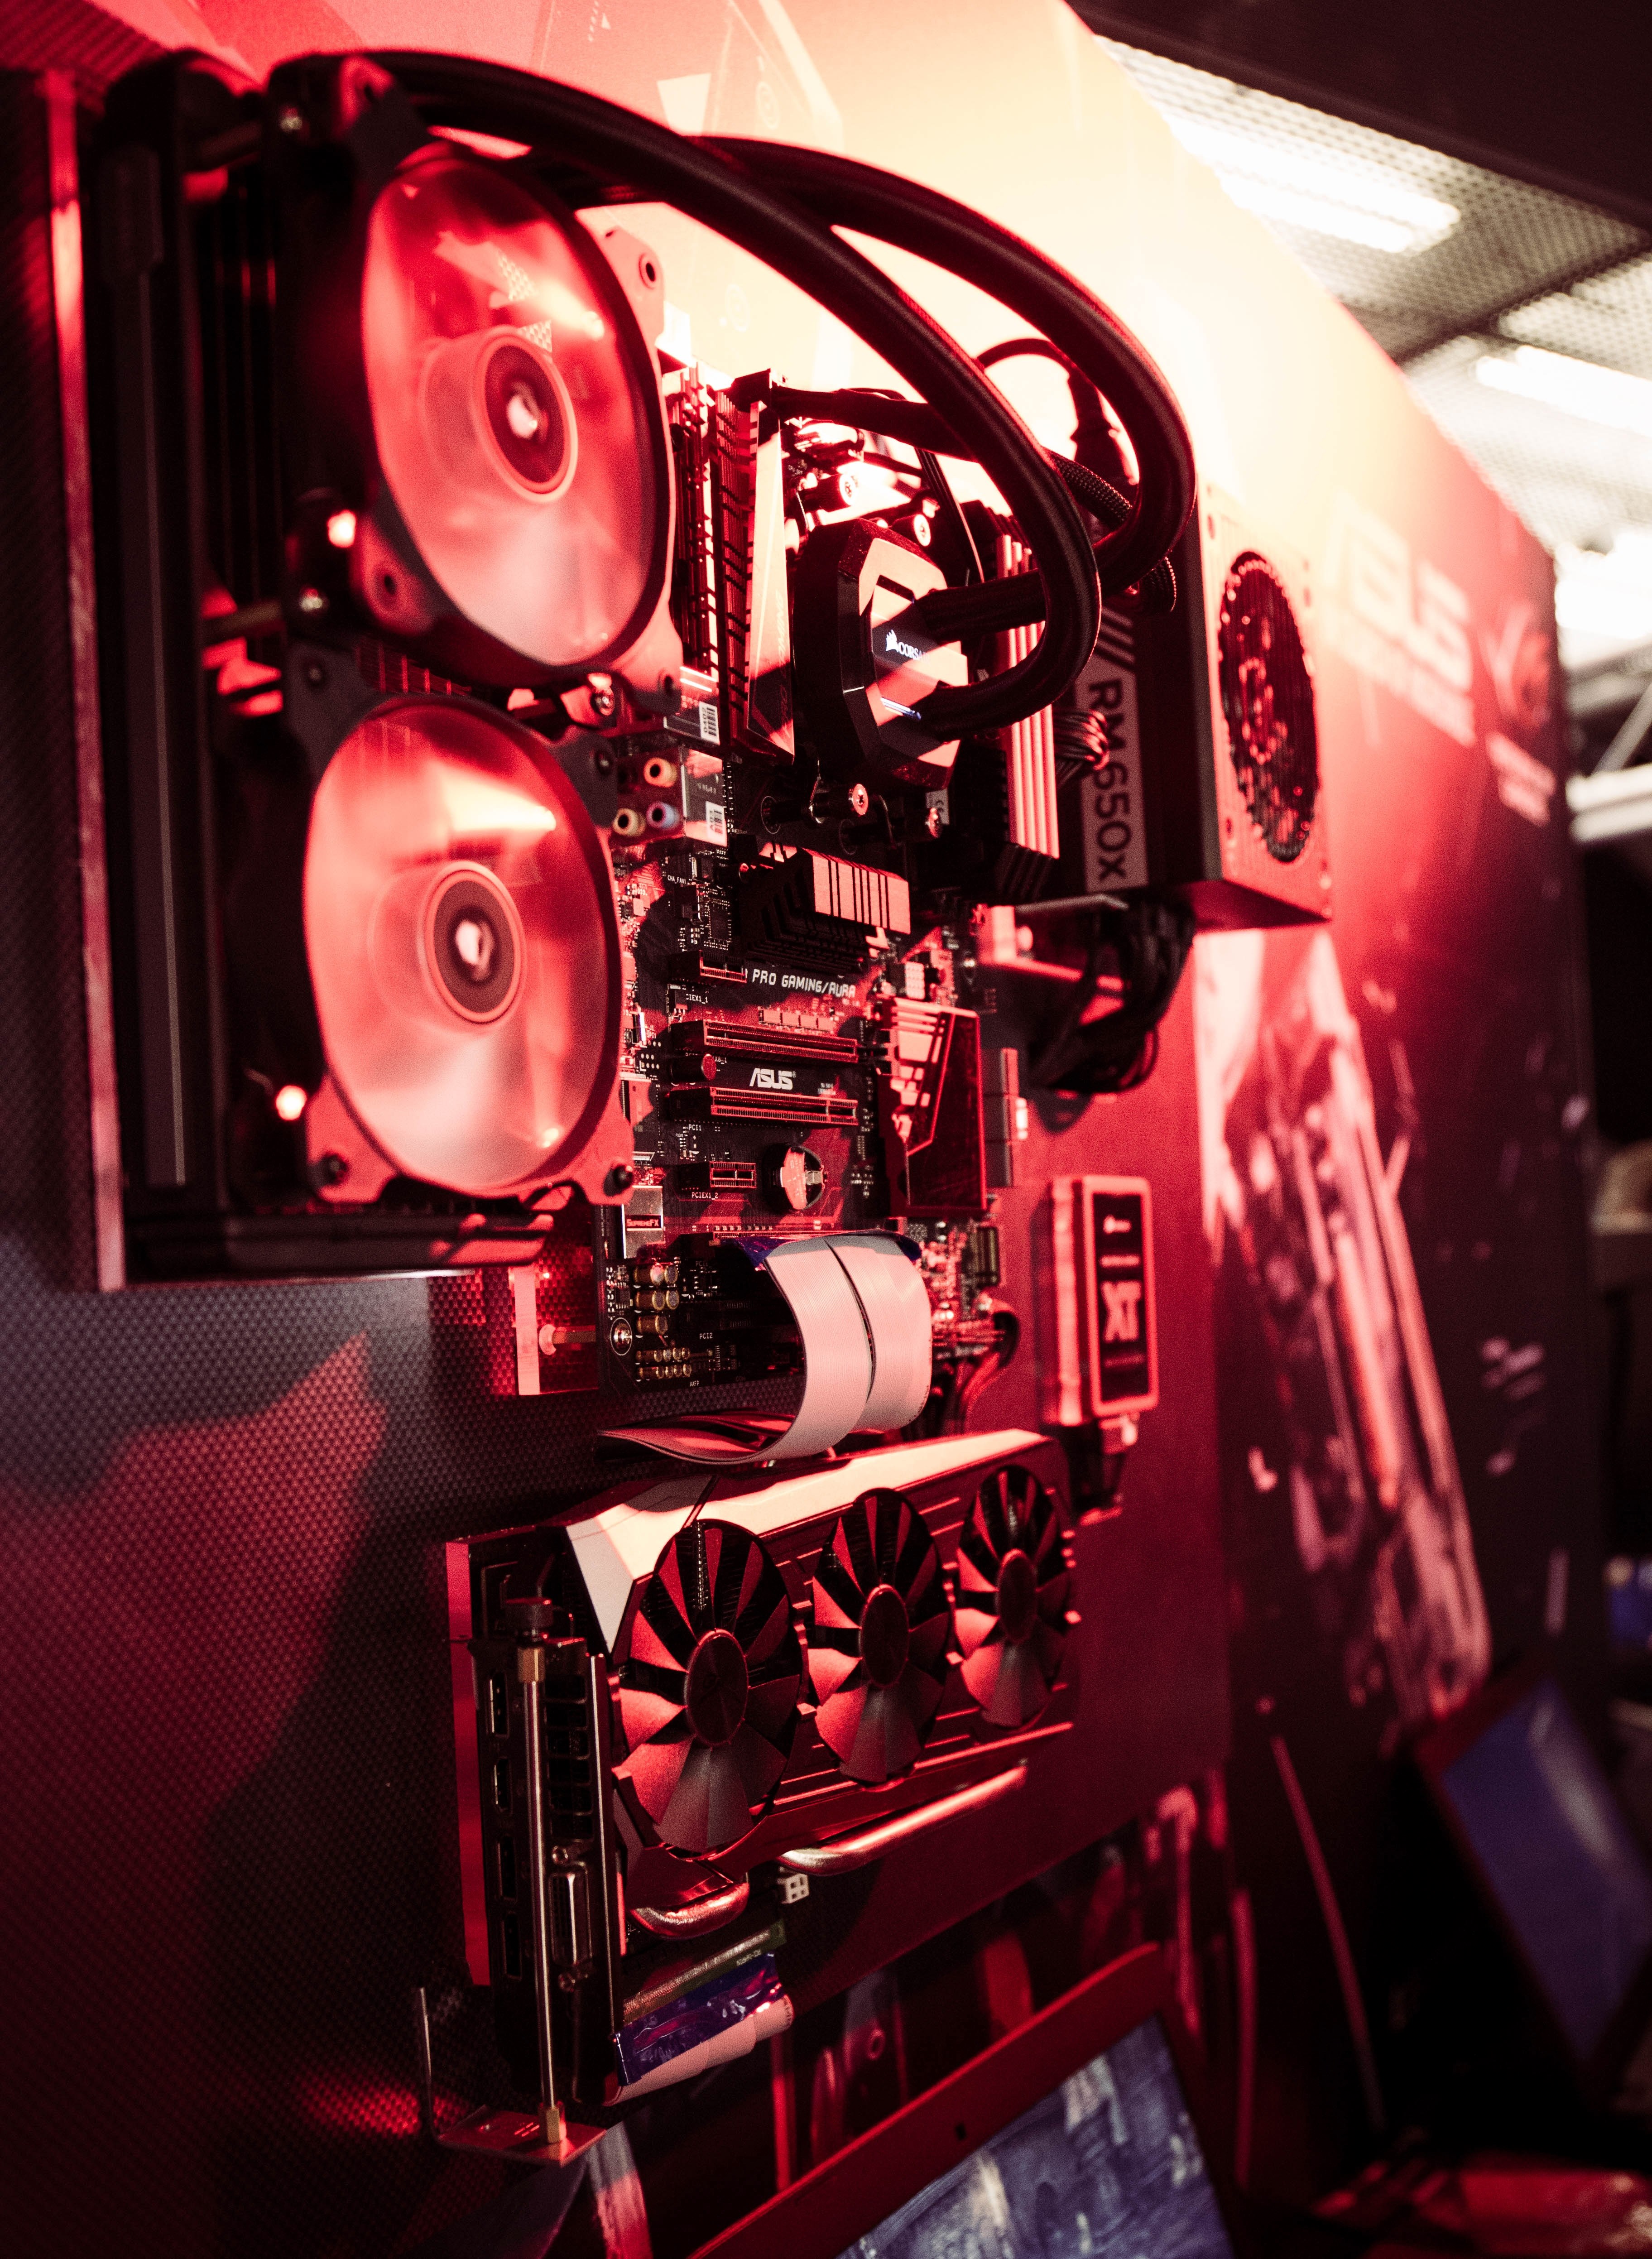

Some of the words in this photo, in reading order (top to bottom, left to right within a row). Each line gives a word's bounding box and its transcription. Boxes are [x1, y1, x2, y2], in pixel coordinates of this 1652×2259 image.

[898, 642, 931, 662] CORSA
[752, 968, 777, 985] PRO
[781, 975, 856, 998] GAMING/AURA
[749, 1067, 793, 1090] ASUS
[692, 1192, 719, 1200] PCIEX1_2
